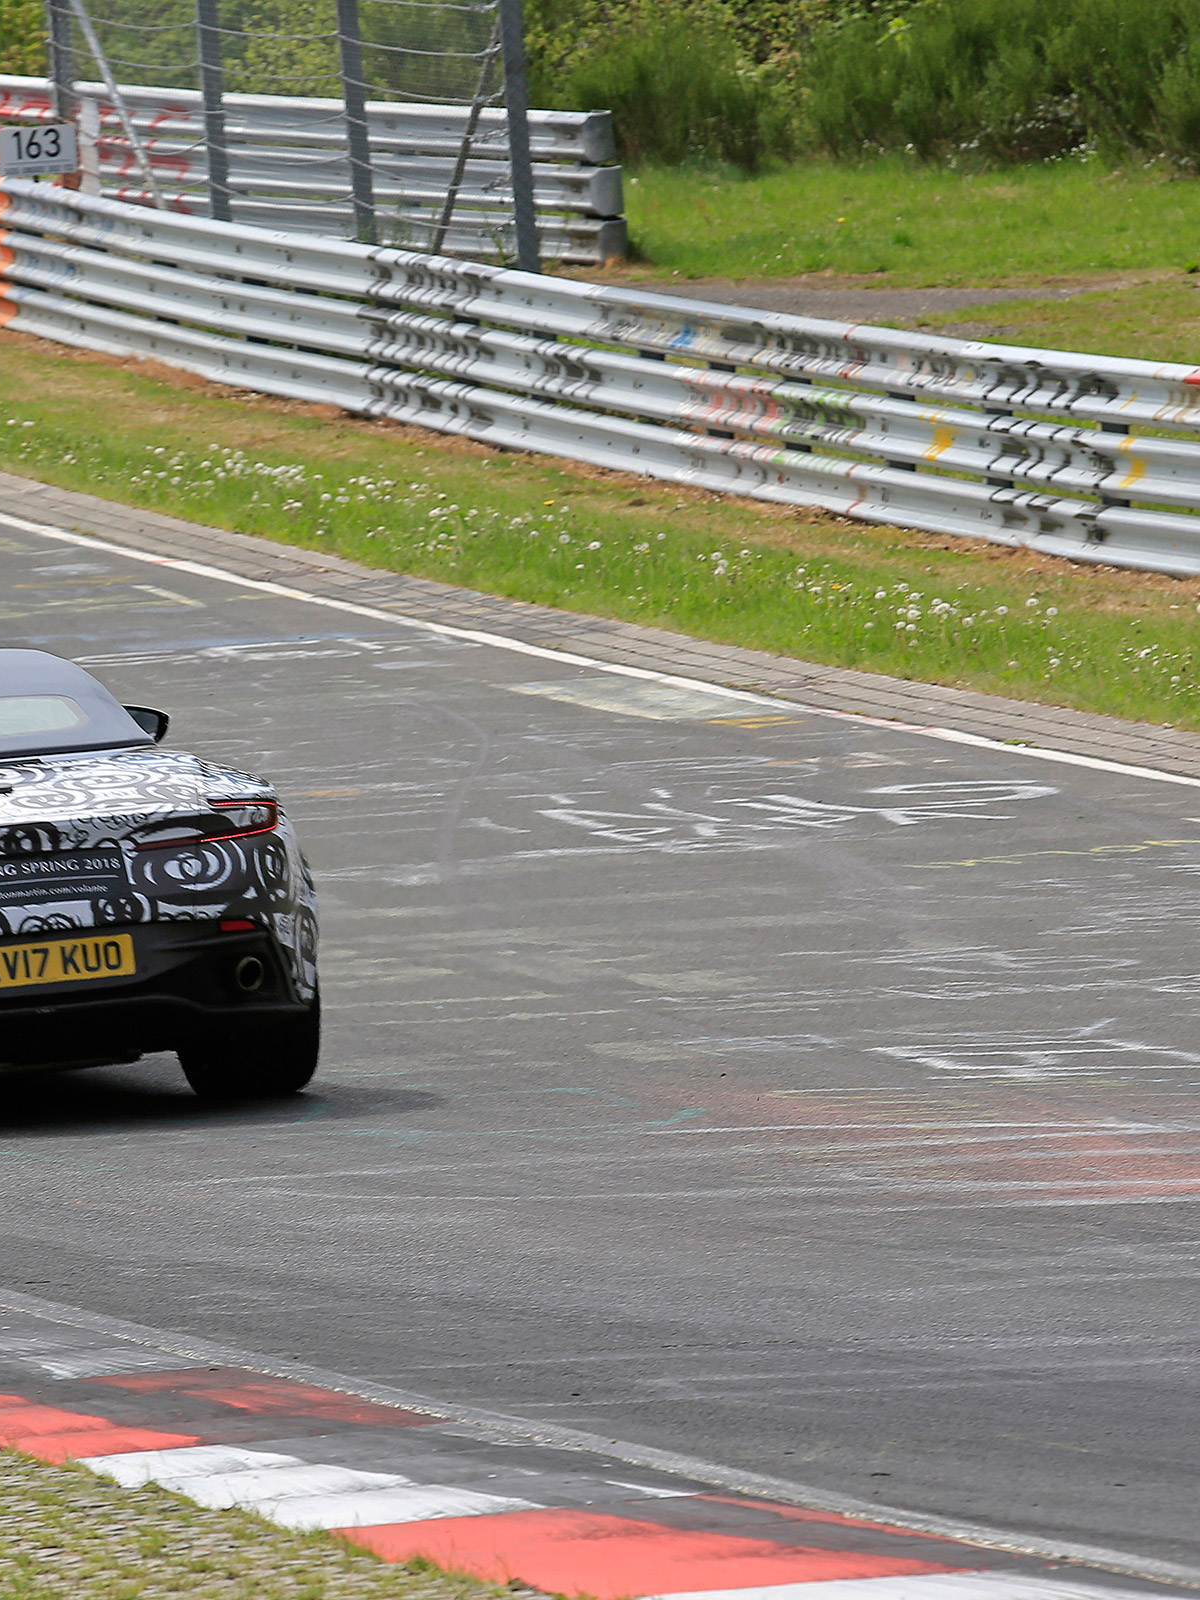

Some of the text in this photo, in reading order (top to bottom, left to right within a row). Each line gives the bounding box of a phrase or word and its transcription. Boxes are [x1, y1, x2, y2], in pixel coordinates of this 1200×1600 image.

[12, 128, 61, 160] 163
[21, 858, 80, 875] SPRING
[83, 857, 121, 870] 2018
[60, 941, 122, 975] KUO
